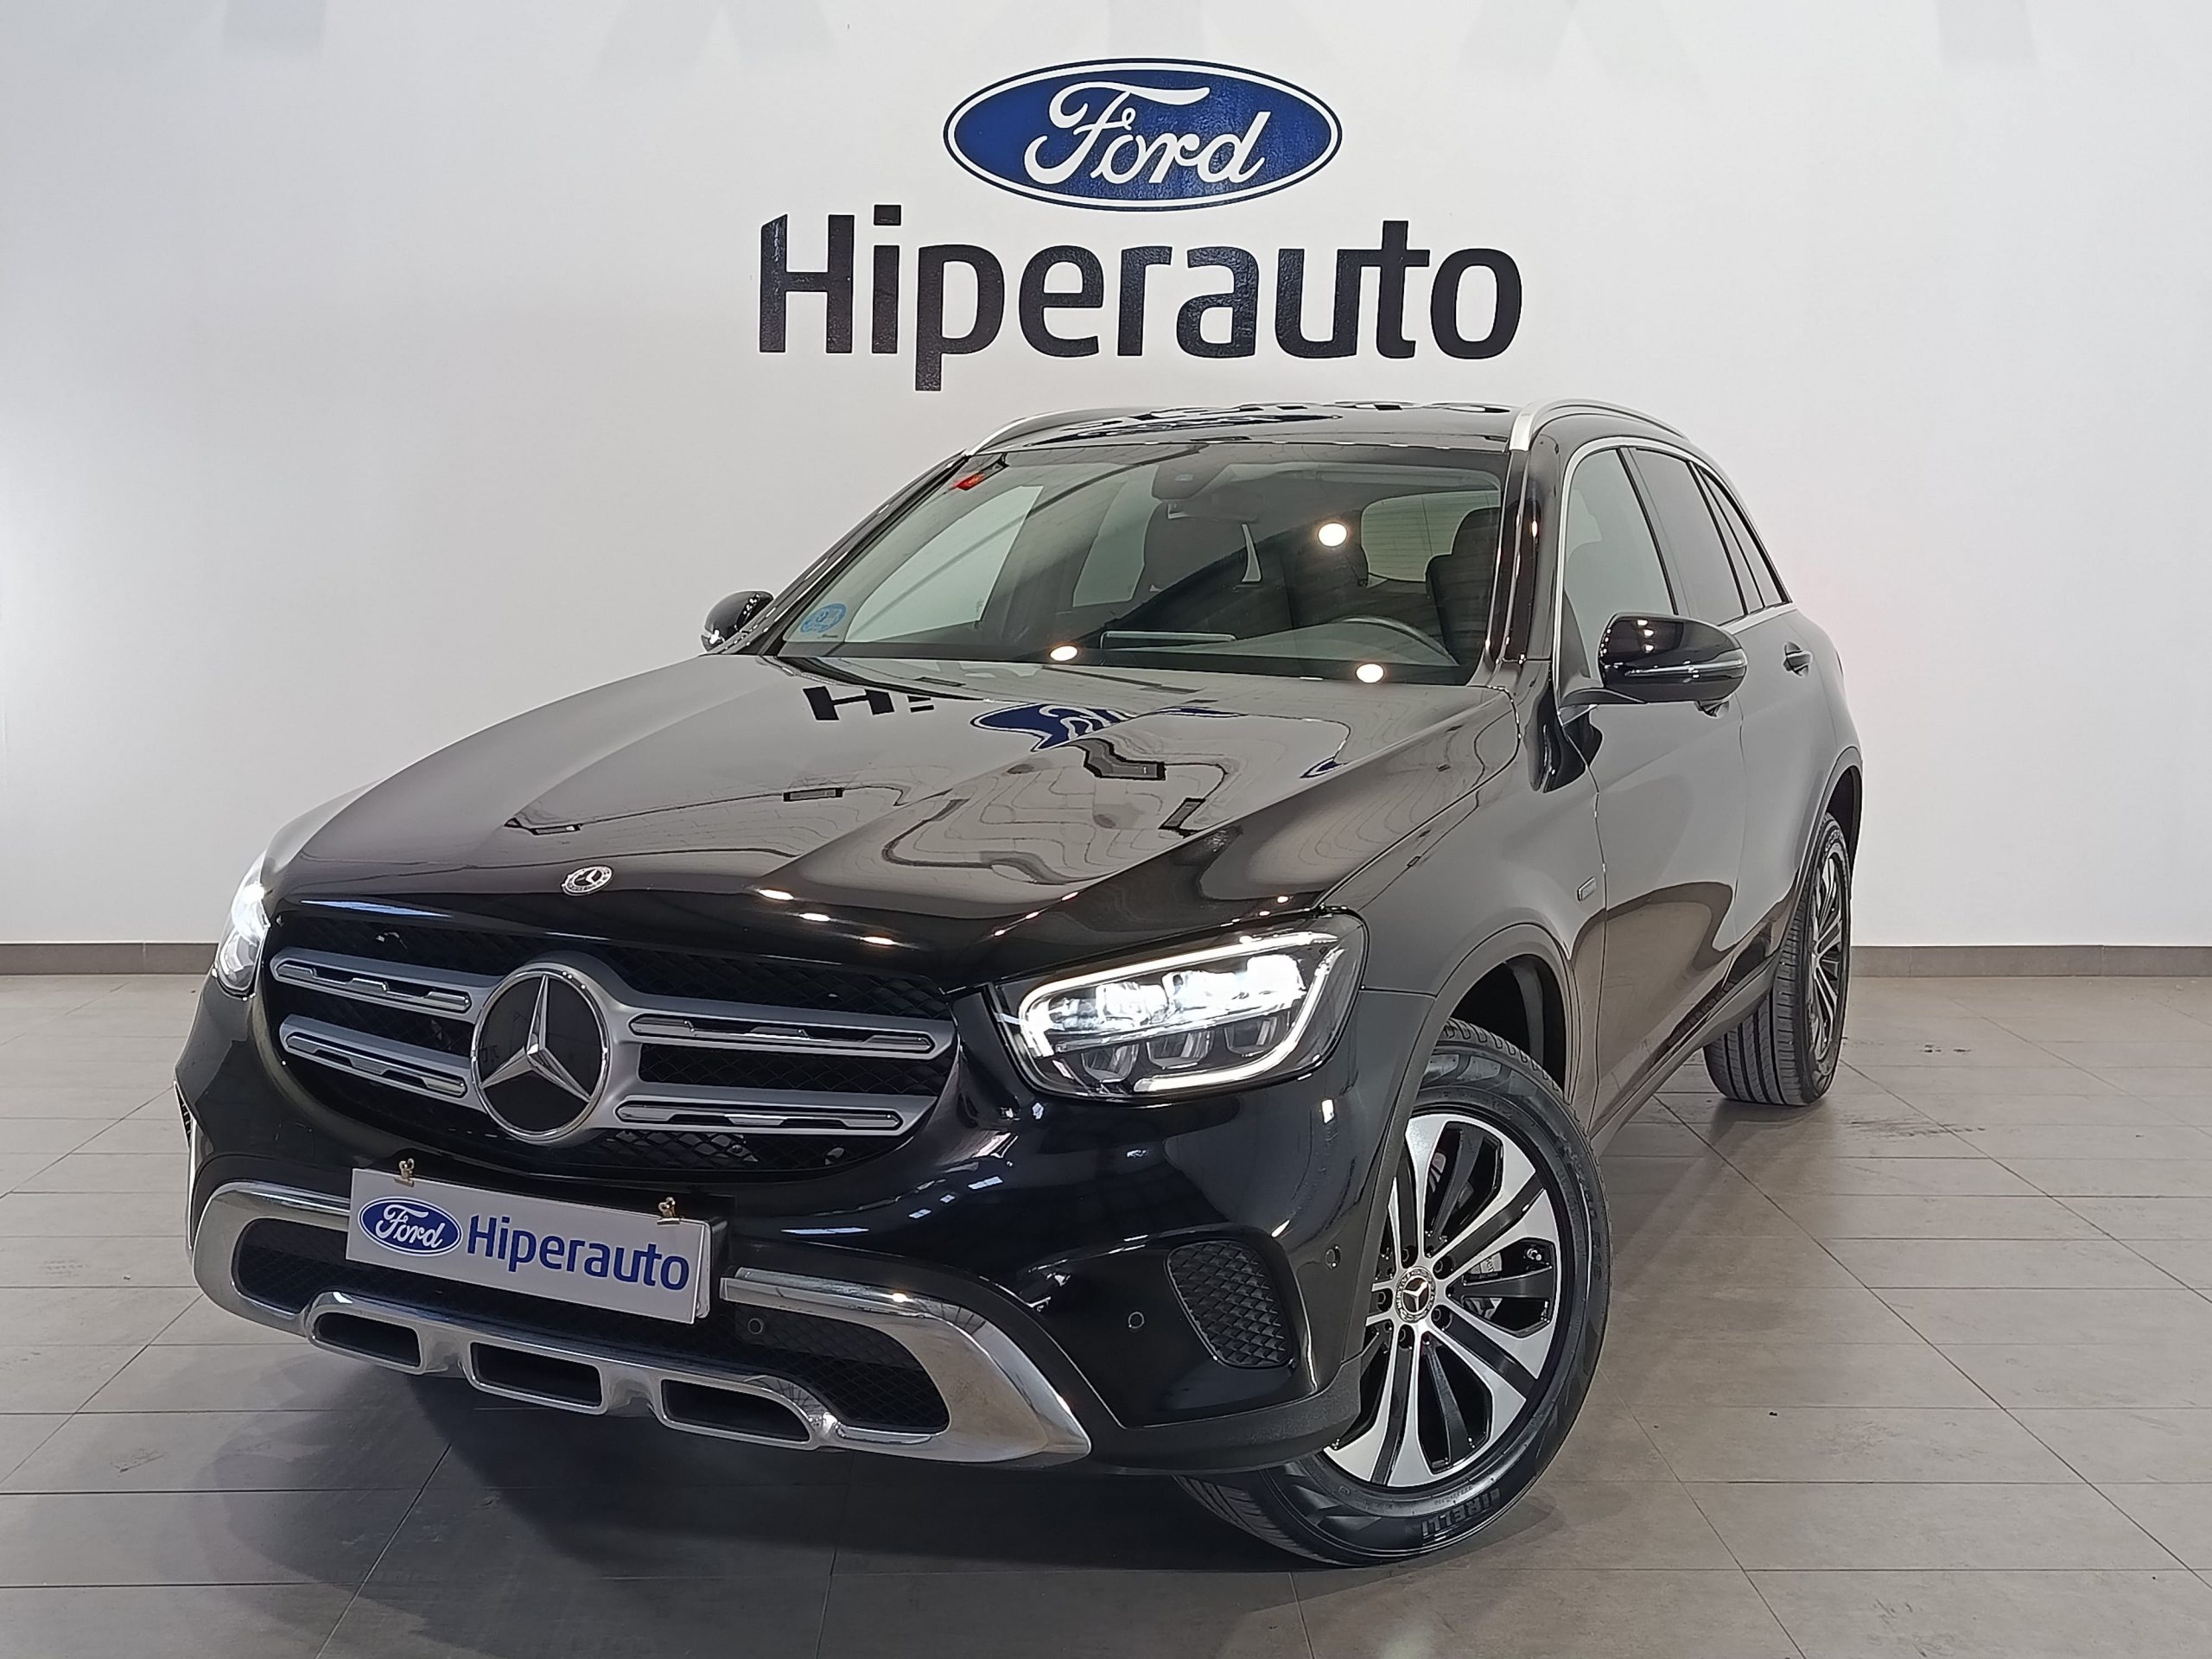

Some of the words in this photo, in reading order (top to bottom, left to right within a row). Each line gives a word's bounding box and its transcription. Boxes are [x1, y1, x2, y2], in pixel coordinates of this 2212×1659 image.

[1025, 81, 1271, 185] Ford
[759, 205, 1522, 392] Hiperauto
[374, 1203, 446, 1249] Ford
[467, 1214, 690, 1291] Hiperauto
[1421, 1488, 1500, 1537] PIRELLI
